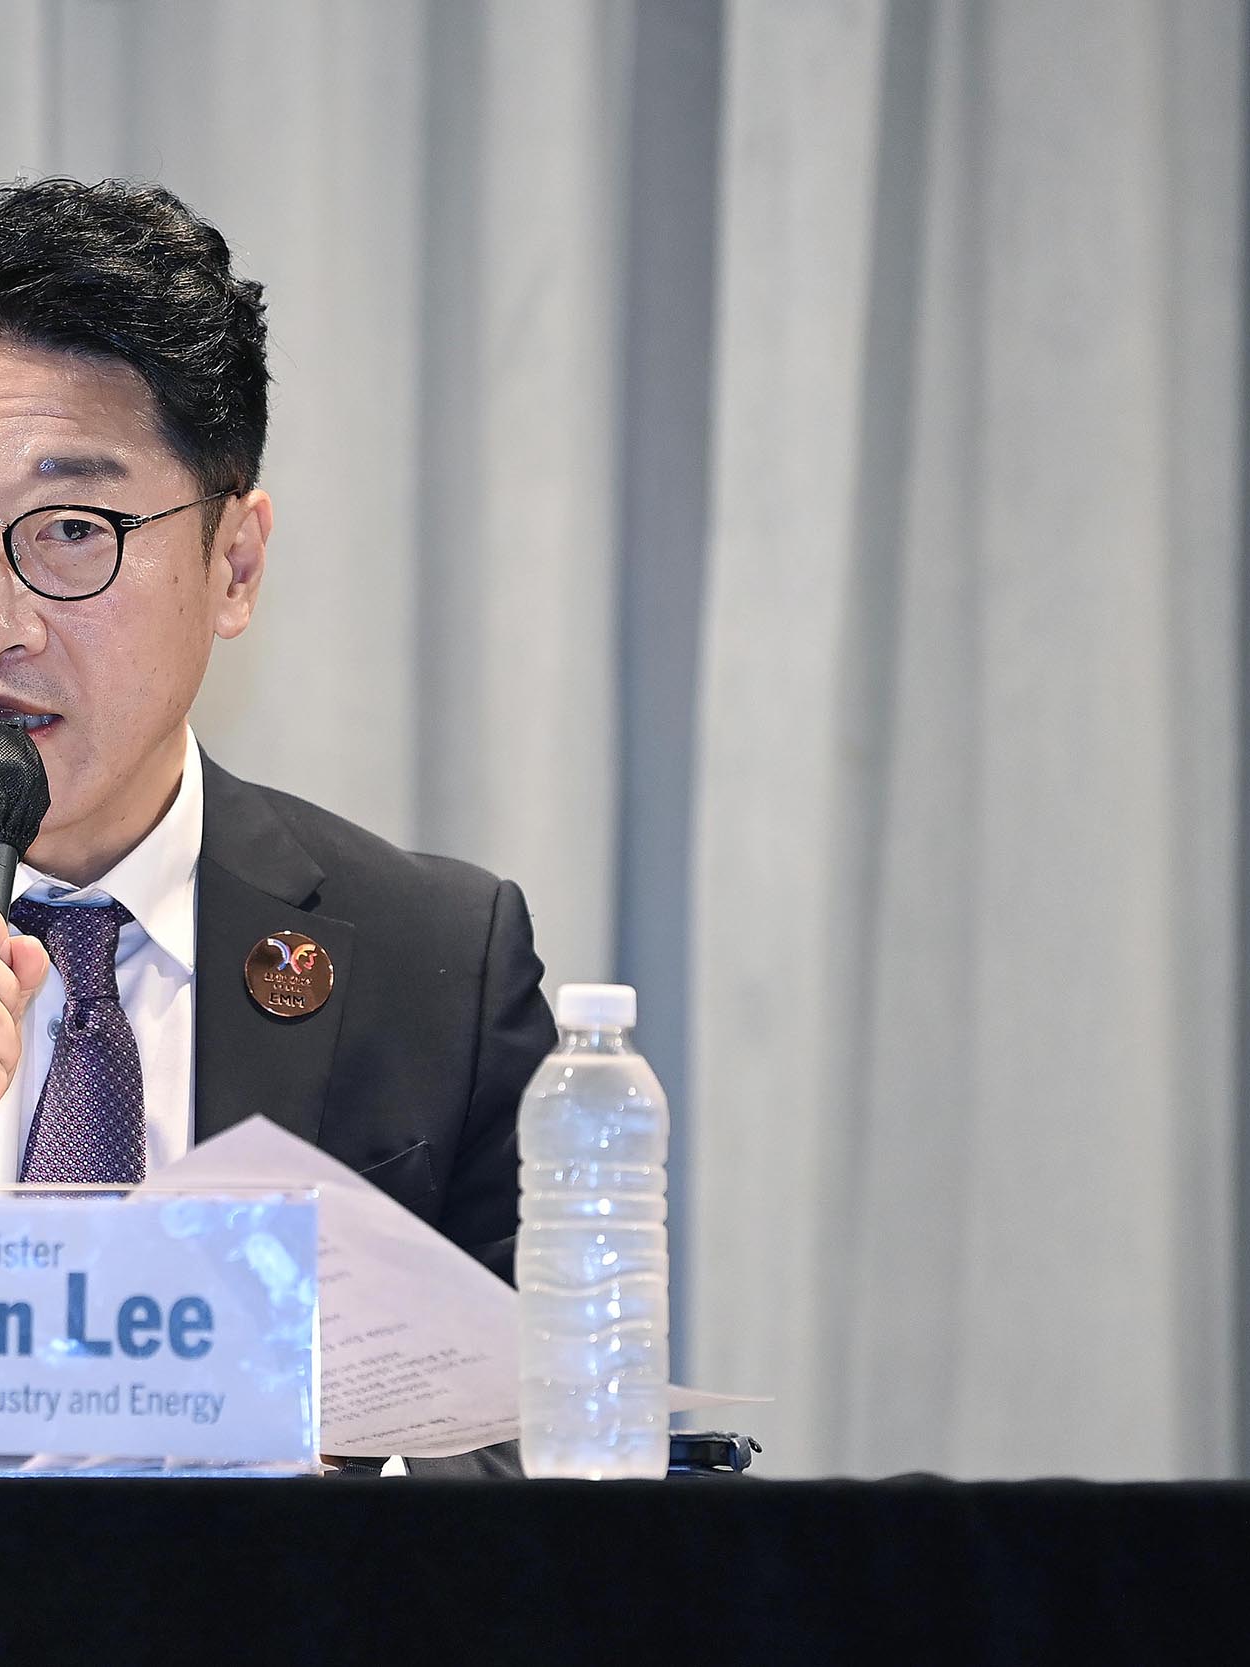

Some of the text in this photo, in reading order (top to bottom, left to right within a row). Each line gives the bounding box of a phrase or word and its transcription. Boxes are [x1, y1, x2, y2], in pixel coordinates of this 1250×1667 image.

[66, 1272, 214, 1359] Lee
[68, 1384, 120, 1416] and
[129, 1384, 226, 1425] Energy
